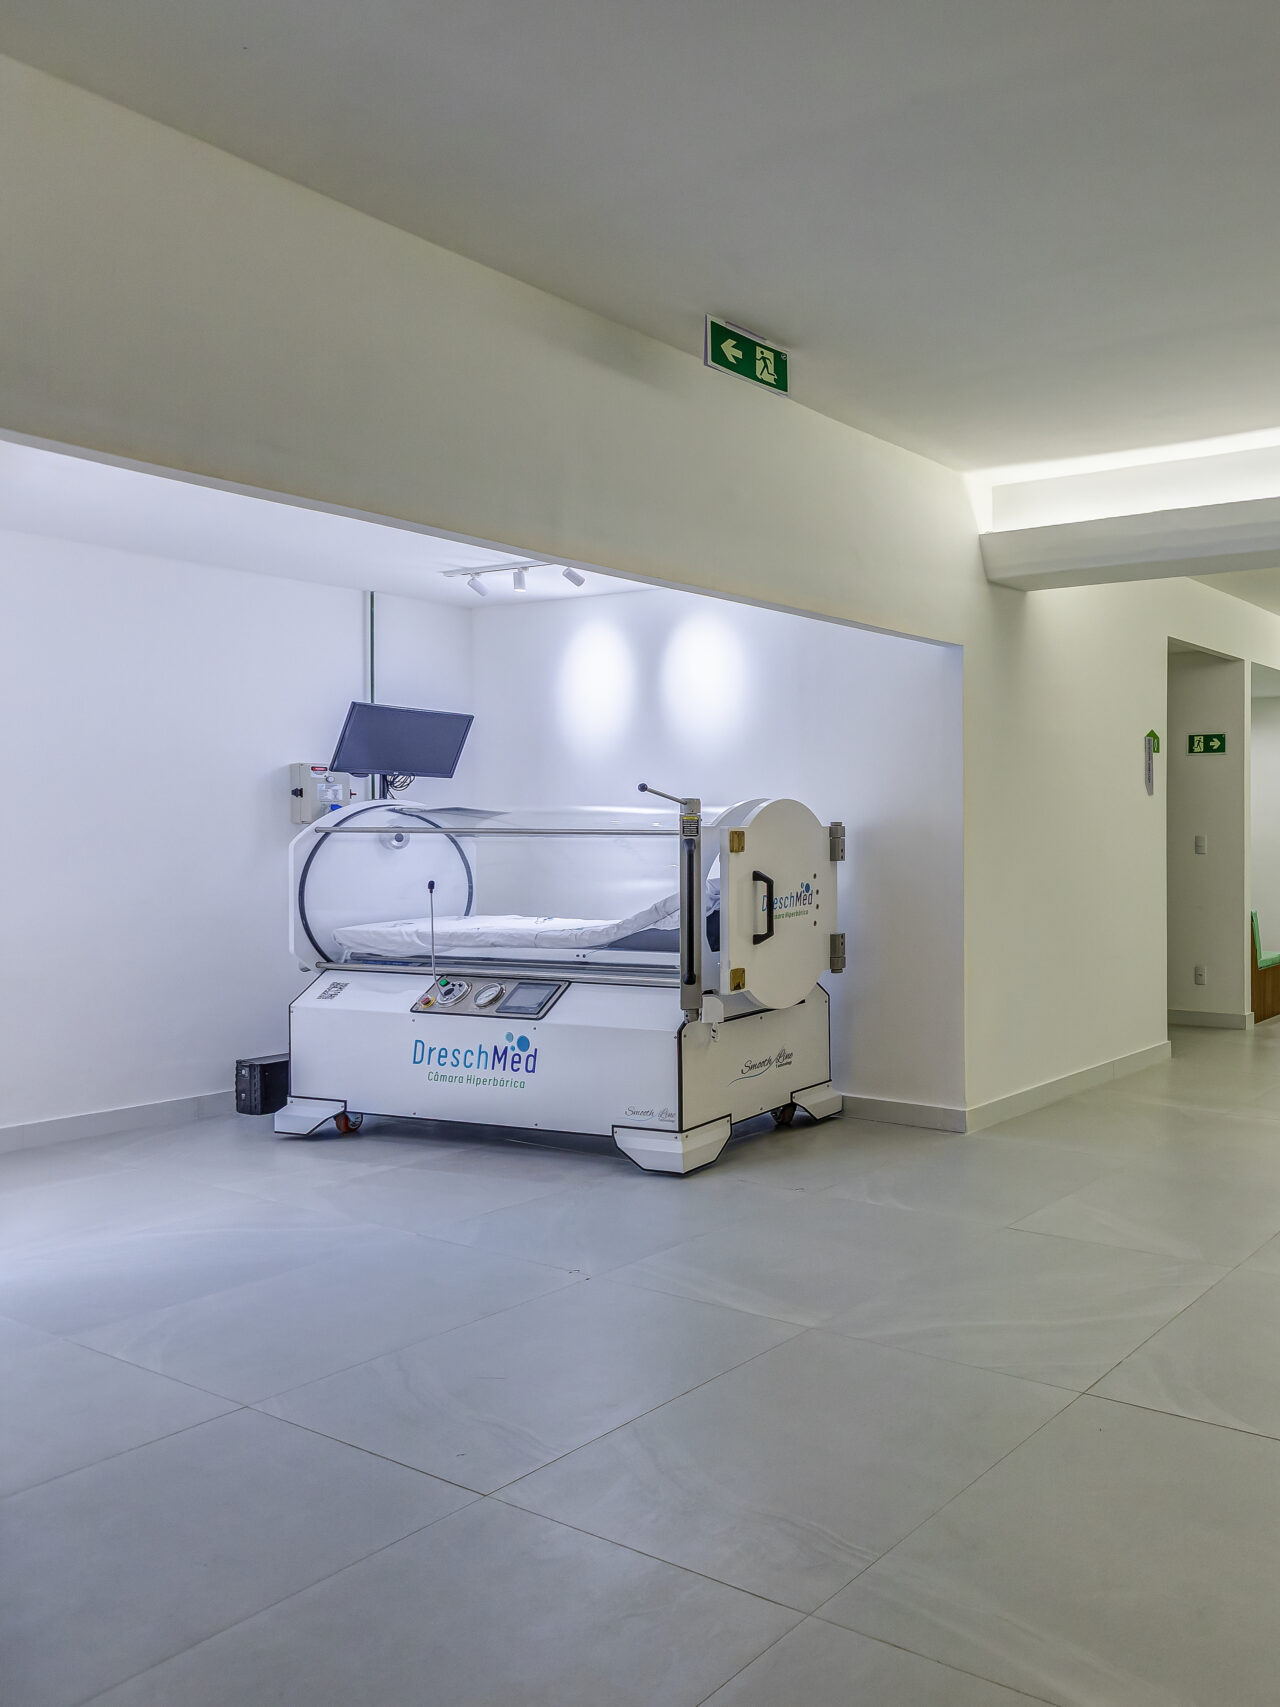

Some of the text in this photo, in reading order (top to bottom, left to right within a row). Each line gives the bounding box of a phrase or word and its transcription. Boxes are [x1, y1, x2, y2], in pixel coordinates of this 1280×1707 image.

[761, 889, 814, 912] DeschMed
[412, 1039, 538, 1073] DreschMed
[428, 1071, 526, 1088] Câmara Hiperbárica
